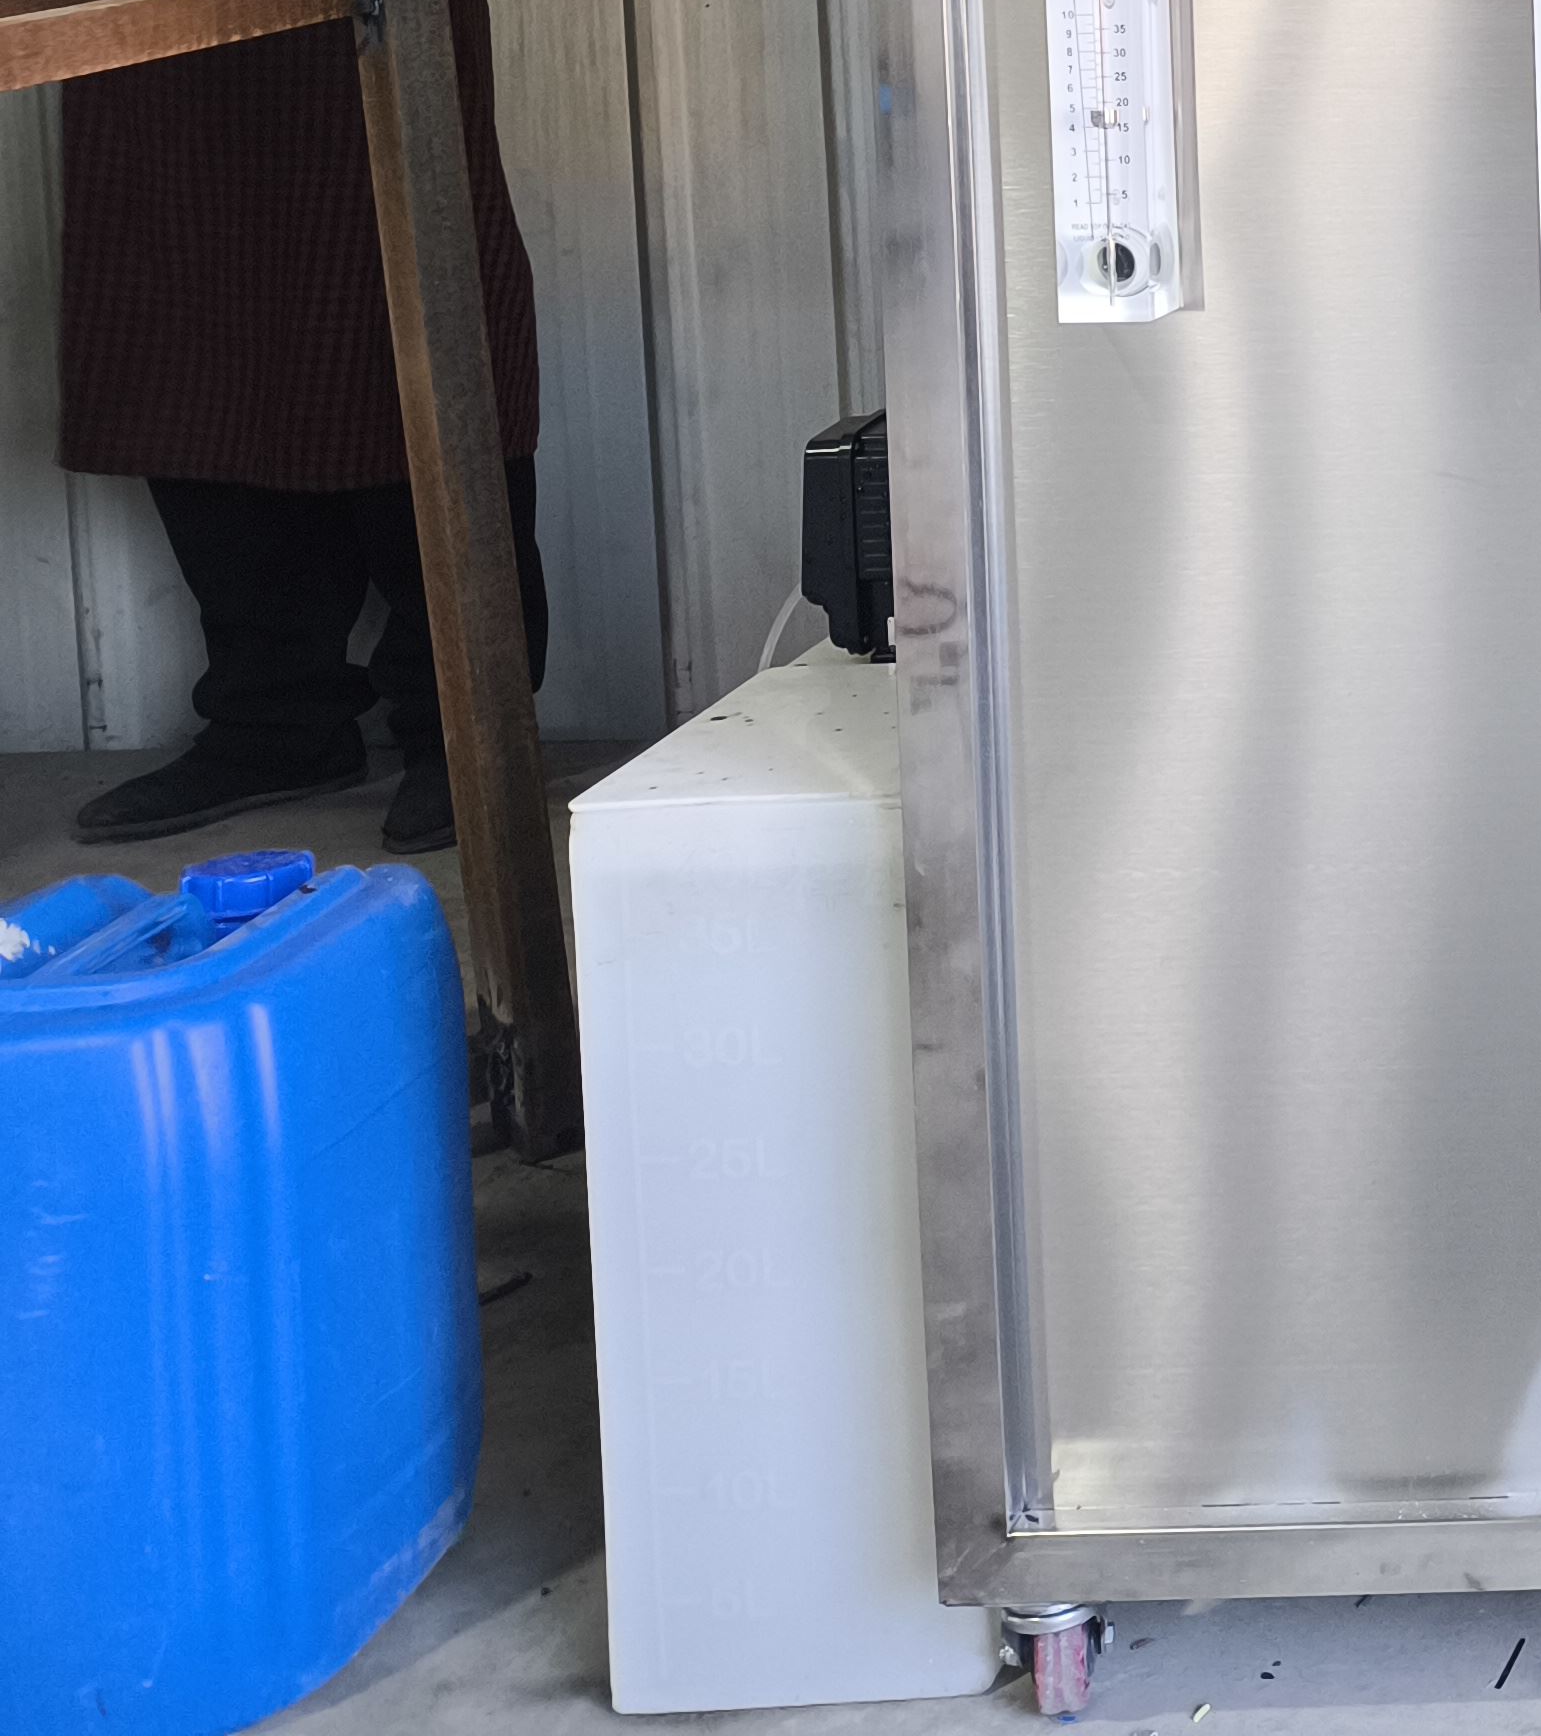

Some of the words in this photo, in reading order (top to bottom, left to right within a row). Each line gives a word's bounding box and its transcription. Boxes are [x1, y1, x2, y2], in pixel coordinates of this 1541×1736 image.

[1062, 10, 1075, 19] 10
[1113, 24, 1126, 34] 35
[1113, 48, 1126, 57] 30
[1114, 72, 1127, 82] 25
[1116, 97, 1129, 107] 20
[1117, 122, 1129, 132] 15
[1119, 154, 1131, 164] 10
[687, 1137, 791, 1180] 25L
[694, 1250, 794, 1292] 20L
